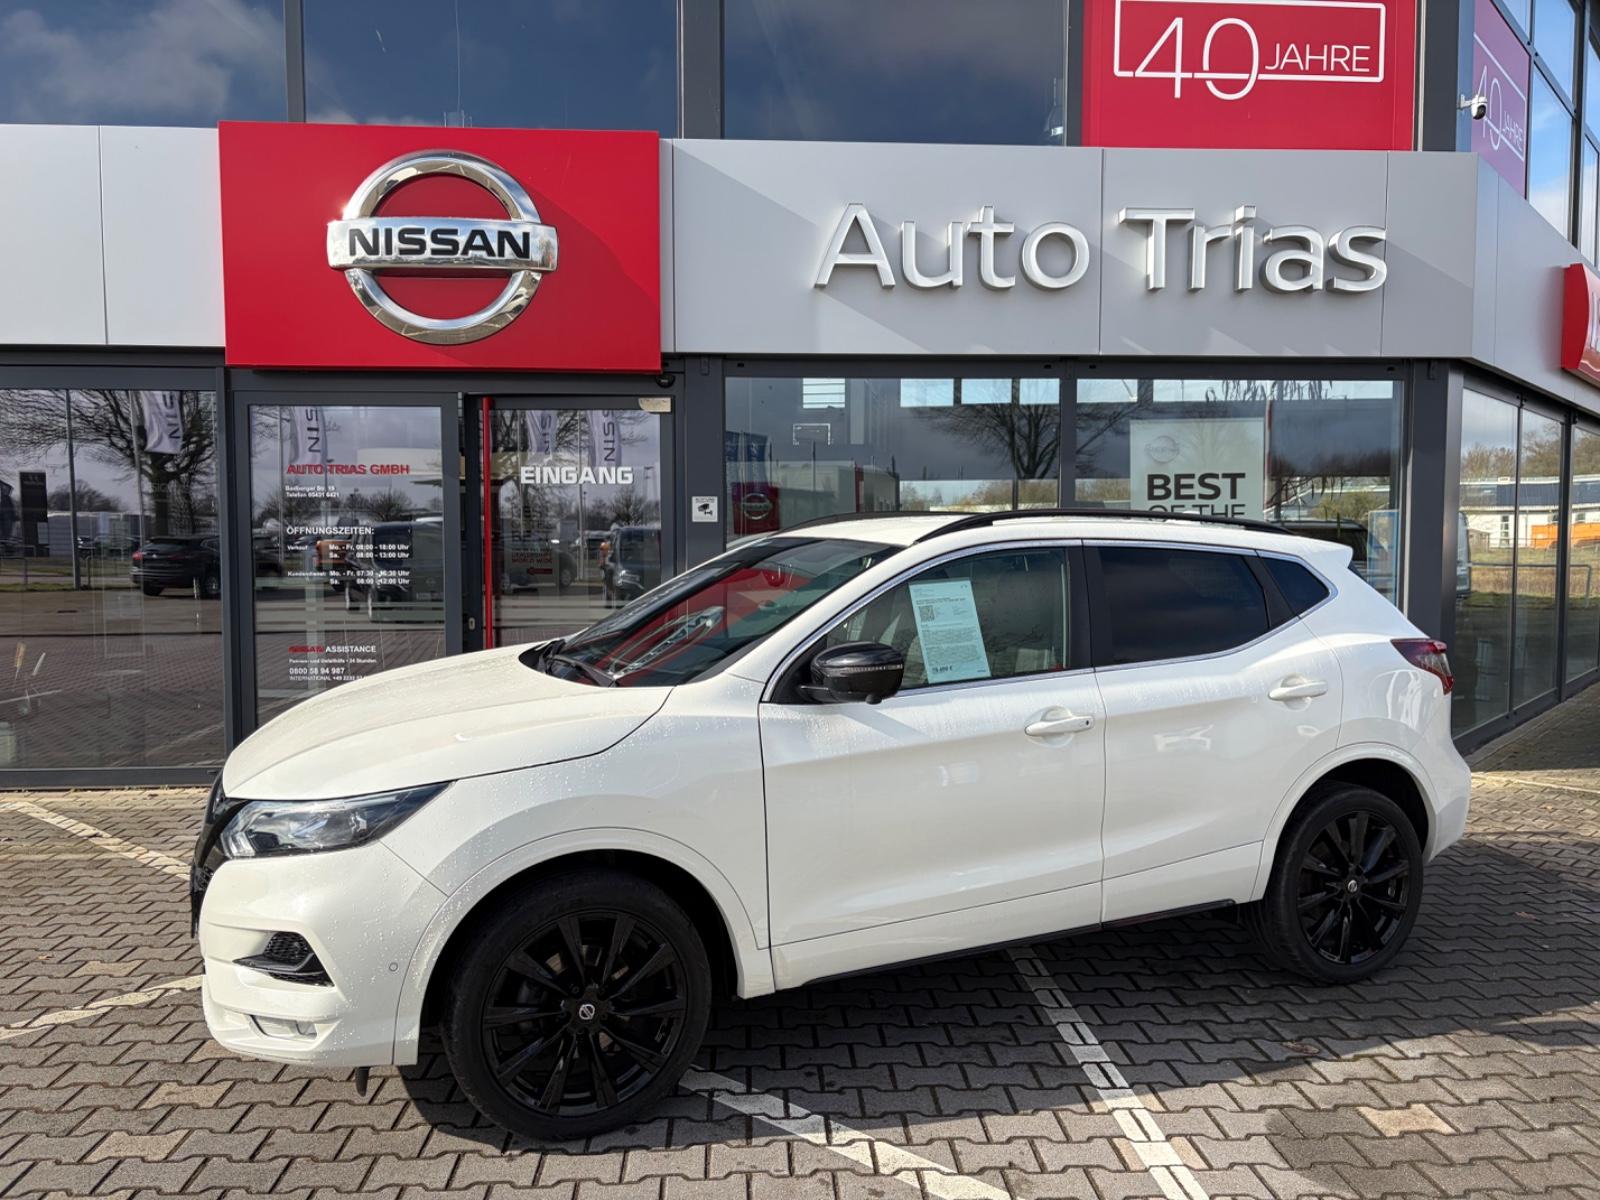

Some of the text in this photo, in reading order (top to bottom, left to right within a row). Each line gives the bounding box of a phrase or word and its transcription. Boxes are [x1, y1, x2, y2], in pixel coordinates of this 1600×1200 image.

[1134, 17, 1371, 101] 40 JAHRE
[348, 227, 531, 260] NISSAN
[814, 202, 1388, 293] Auto Trias
[286, 463, 410, 475] AUTO TRIAS GMBH
[519, 465, 634, 485] EINGANG
[1146, 472, 1246, 501] BEST
[286, 525, 375, 535] ÖFFNUNGSZEITEN:
[325, 645, 377, 653] ASSISTANCE
[289, 667, 308, 675] 0800
[320, 667, 330, 675] 94
